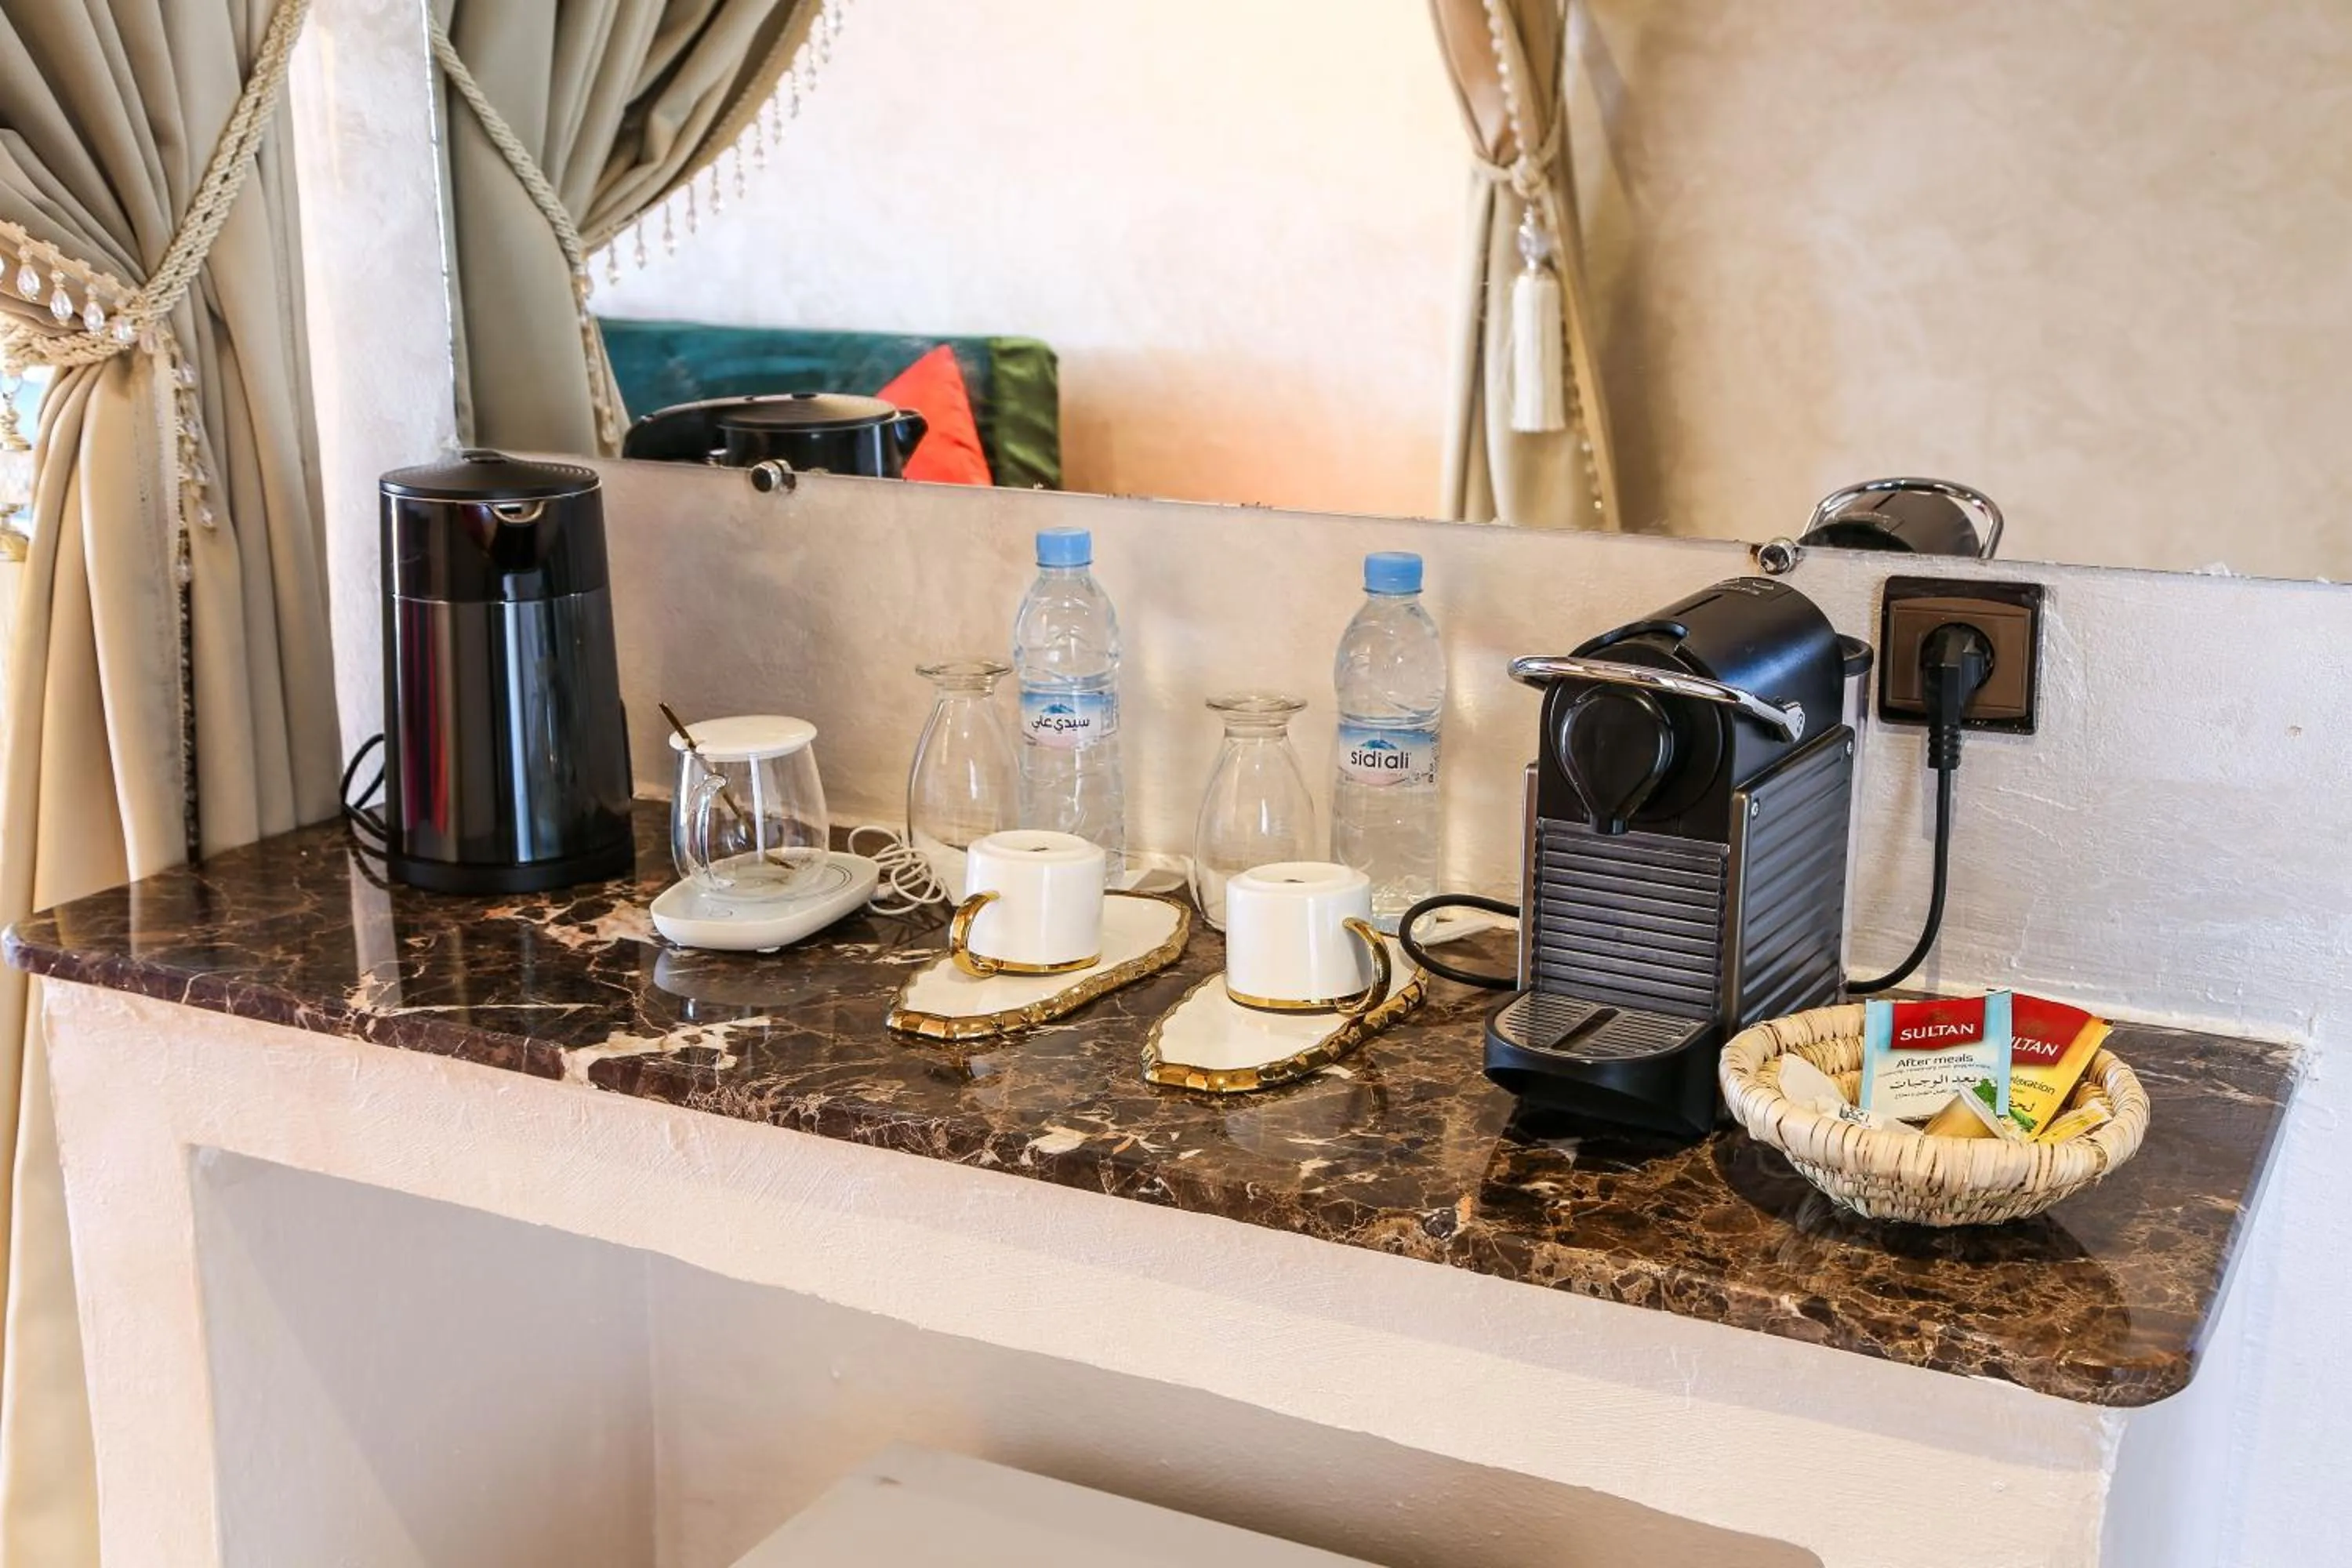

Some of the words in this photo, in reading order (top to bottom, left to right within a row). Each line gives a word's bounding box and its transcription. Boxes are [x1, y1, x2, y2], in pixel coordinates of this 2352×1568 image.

[1032, 714, 1053, 732] علي
[1054, 717, 1090, 734] سيدي
[1351, 750, 1381, 768] sidi
[1385, 751, 1410, 769] ali
[1900, 1023, 1975, 1041] SULTAN
[2011, 1036, 2059, 1056] LTAN
[1896, 1057, 1932, 1068] After
[1933, 1054, 1974, 1064] meals
[1889, 1074, 1948, 1089] الوجبات
[1952, 1075, 1976, 1086] بعد
